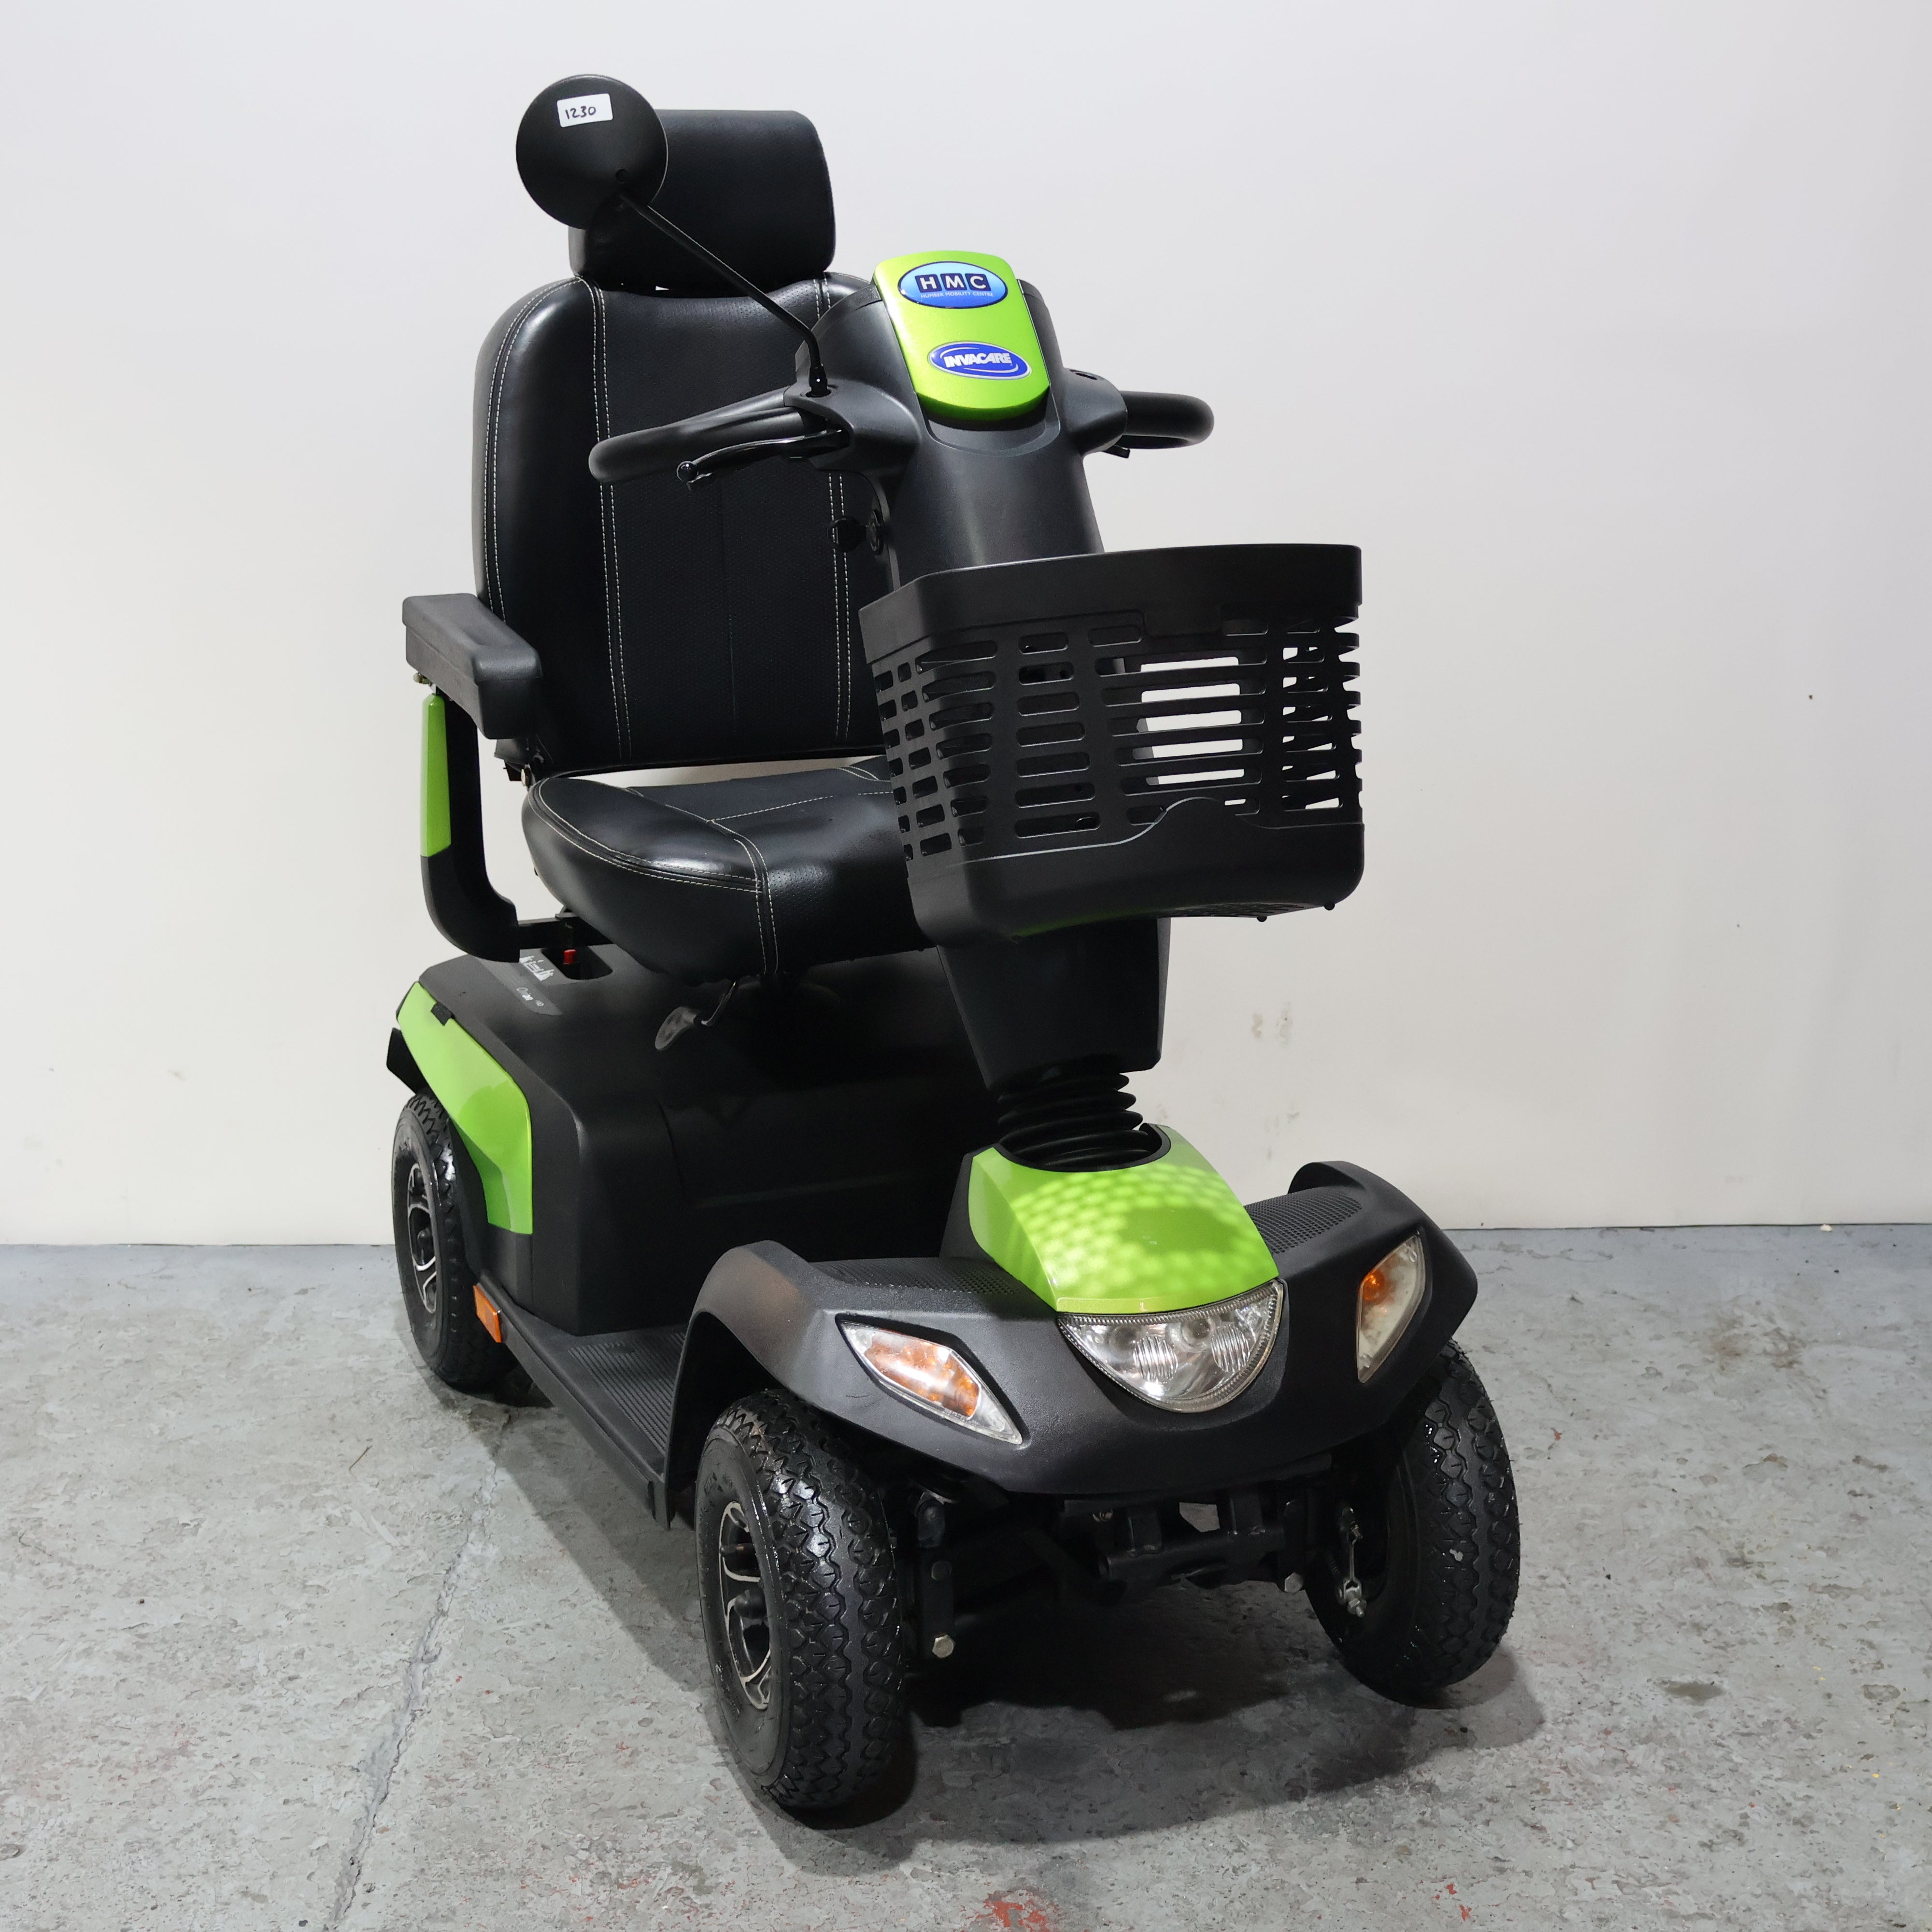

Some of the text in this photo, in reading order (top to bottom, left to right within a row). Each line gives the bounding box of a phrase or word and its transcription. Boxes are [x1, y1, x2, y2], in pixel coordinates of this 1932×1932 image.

[565, 106, 597, 119] 1230
[919, 275, 986, 290] HMC
[943, 353, 1012, 368] INVACARE
